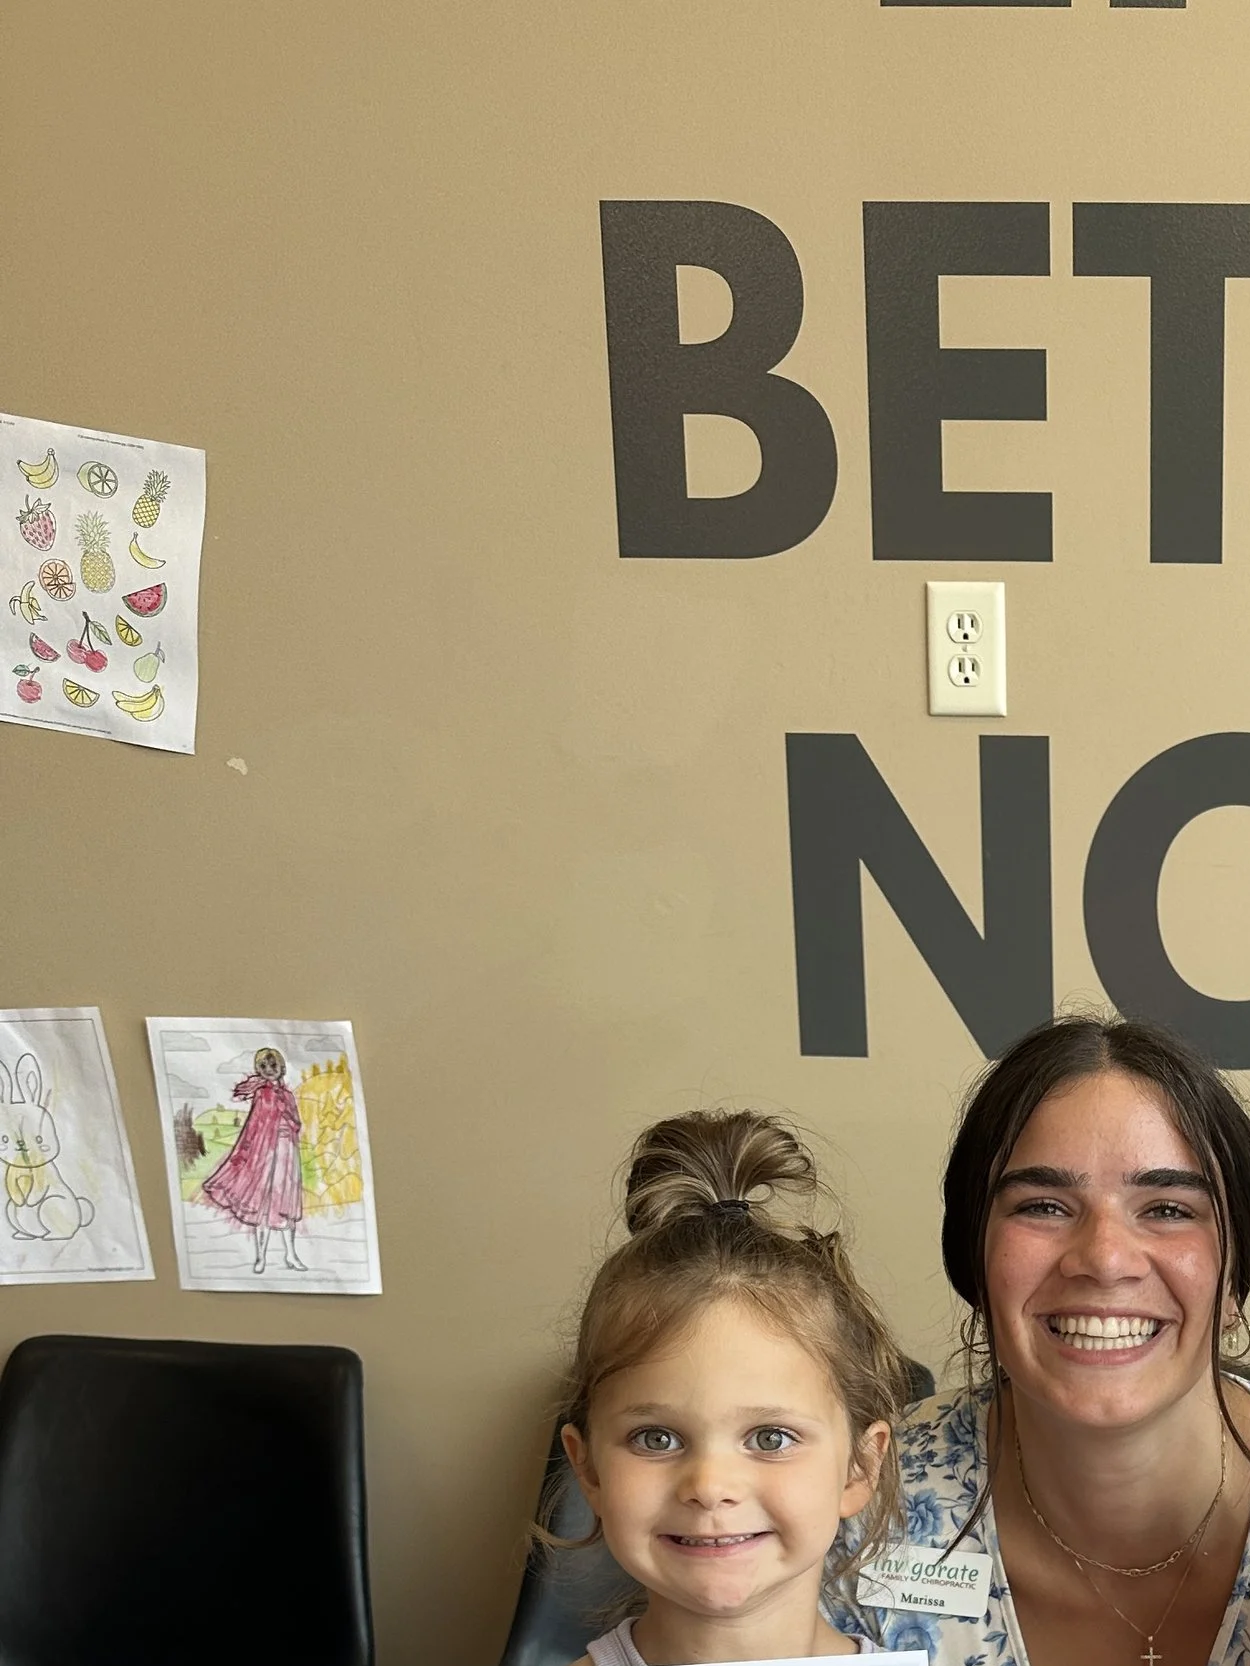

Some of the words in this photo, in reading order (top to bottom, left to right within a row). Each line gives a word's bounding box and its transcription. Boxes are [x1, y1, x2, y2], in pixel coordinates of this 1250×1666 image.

[881, 1573, 909, 1582] FAMILY
[921, 1577, 976, 1590] CHIROPRACTIC
[900, 1593, 945, 1607] Marissa
